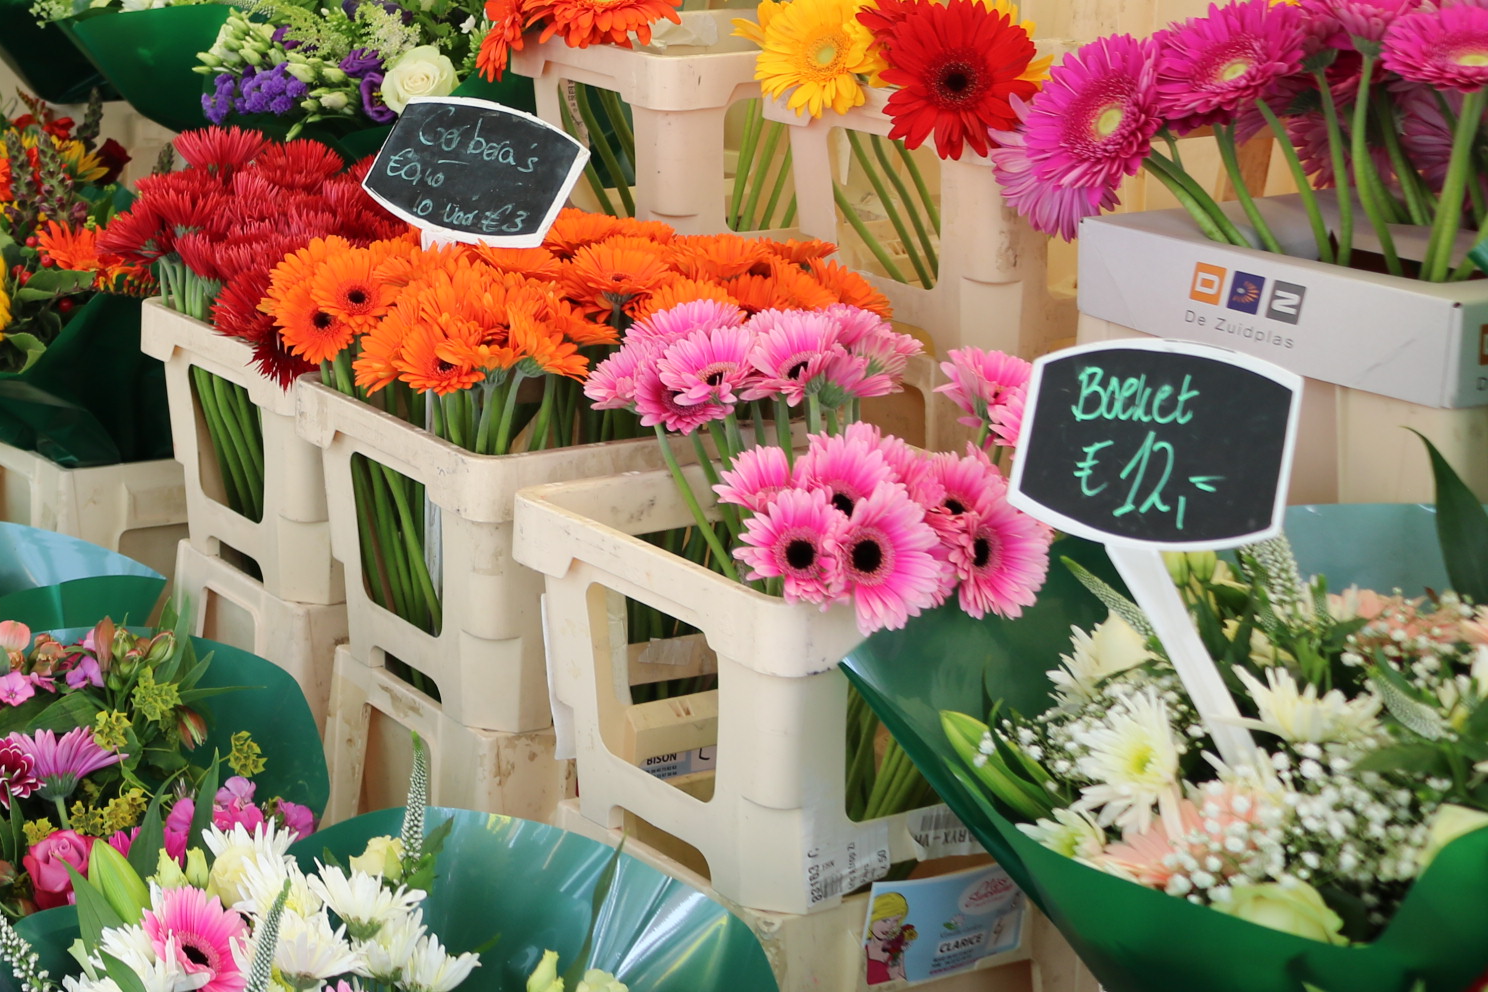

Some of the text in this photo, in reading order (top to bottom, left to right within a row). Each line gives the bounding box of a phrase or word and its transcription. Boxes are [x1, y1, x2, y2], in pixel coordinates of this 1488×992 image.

[419, 106, 539, 174] Gerbera's
[1184, 309, 1295, 349] De Zuidplas
[1071, 365, 1201, 424] Boeket
[939, 933, 983, 954] CLARICE
